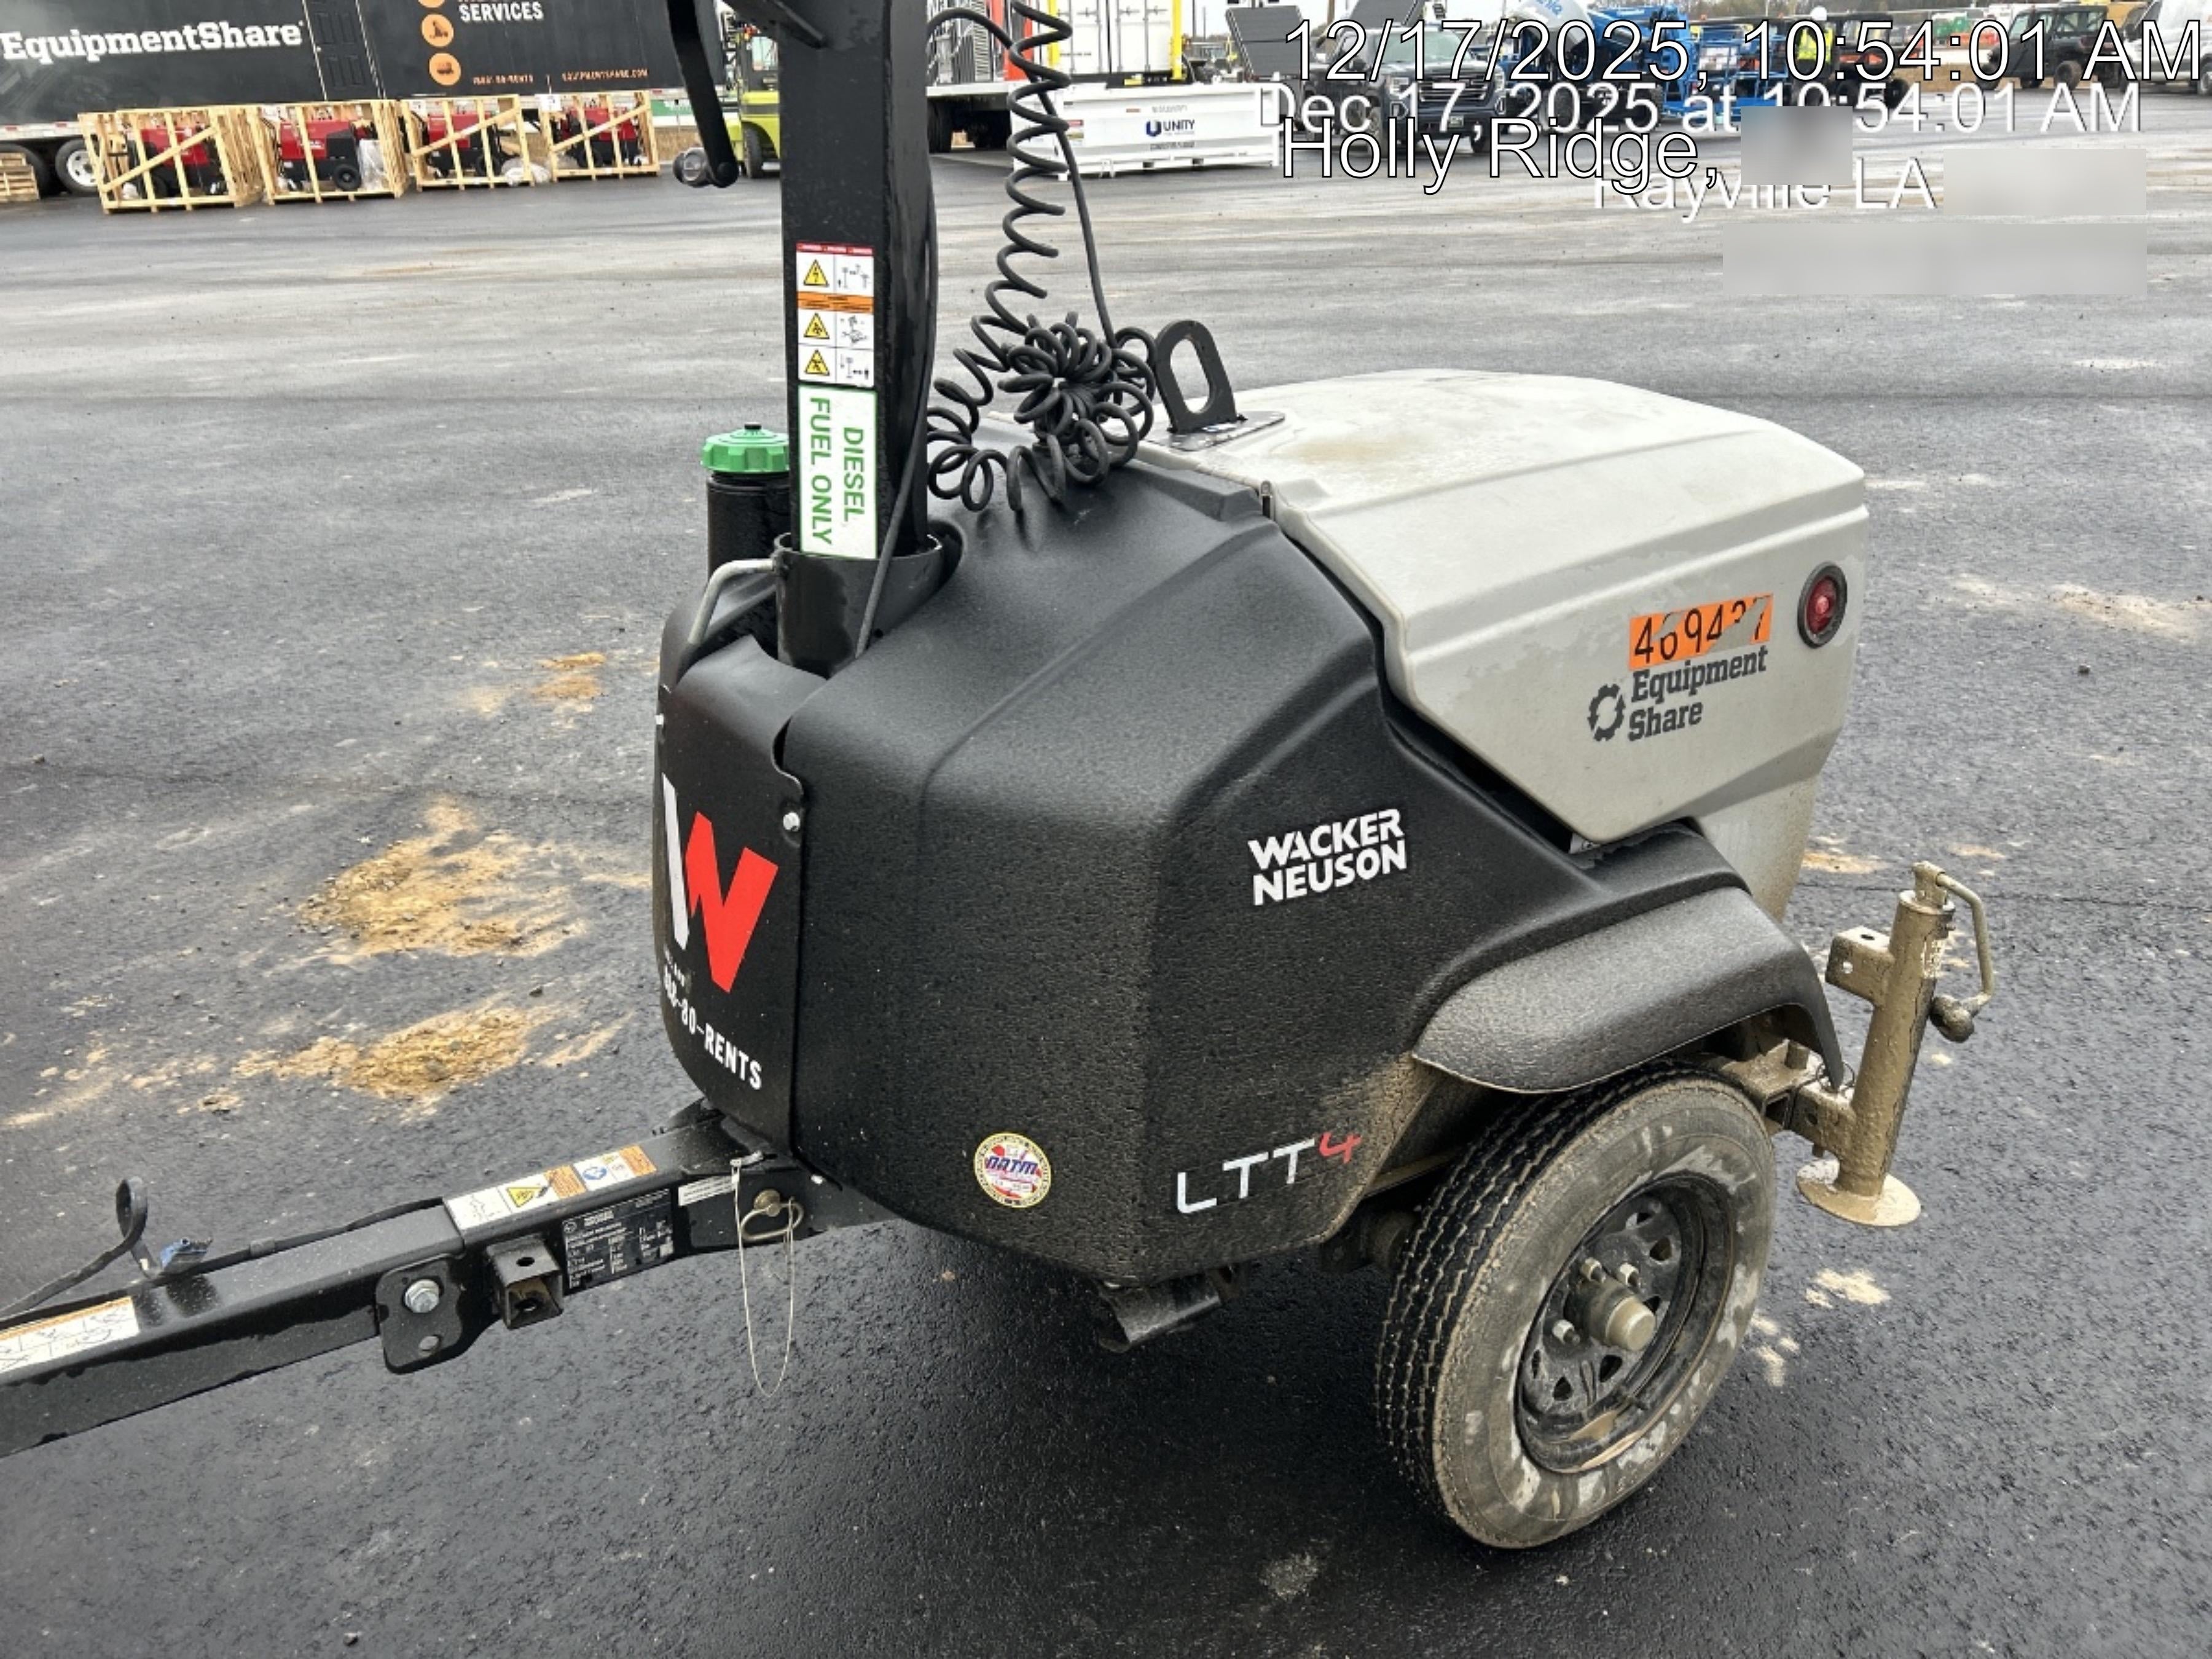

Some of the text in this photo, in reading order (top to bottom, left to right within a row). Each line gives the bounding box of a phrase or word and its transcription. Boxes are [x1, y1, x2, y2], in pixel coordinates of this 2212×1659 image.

[458, 1, 544, 22] SERVICES
[0, 20, 304, 63] EquipmentShare
[1163, 119, 1195, 131] UNITY
[810, 398, 833, 545] FUEL ONLY
[844, 427, 865, 522] DIESEL
[1631, 646, 1768, 703] Equipment
[1628, 702, 1703, 742] Share
[1247, 809, 1405, 870] WACKER
[1253, 839, 1407, 906] NEUSON
[1177, 1132, 1362, 1214] LTT4
